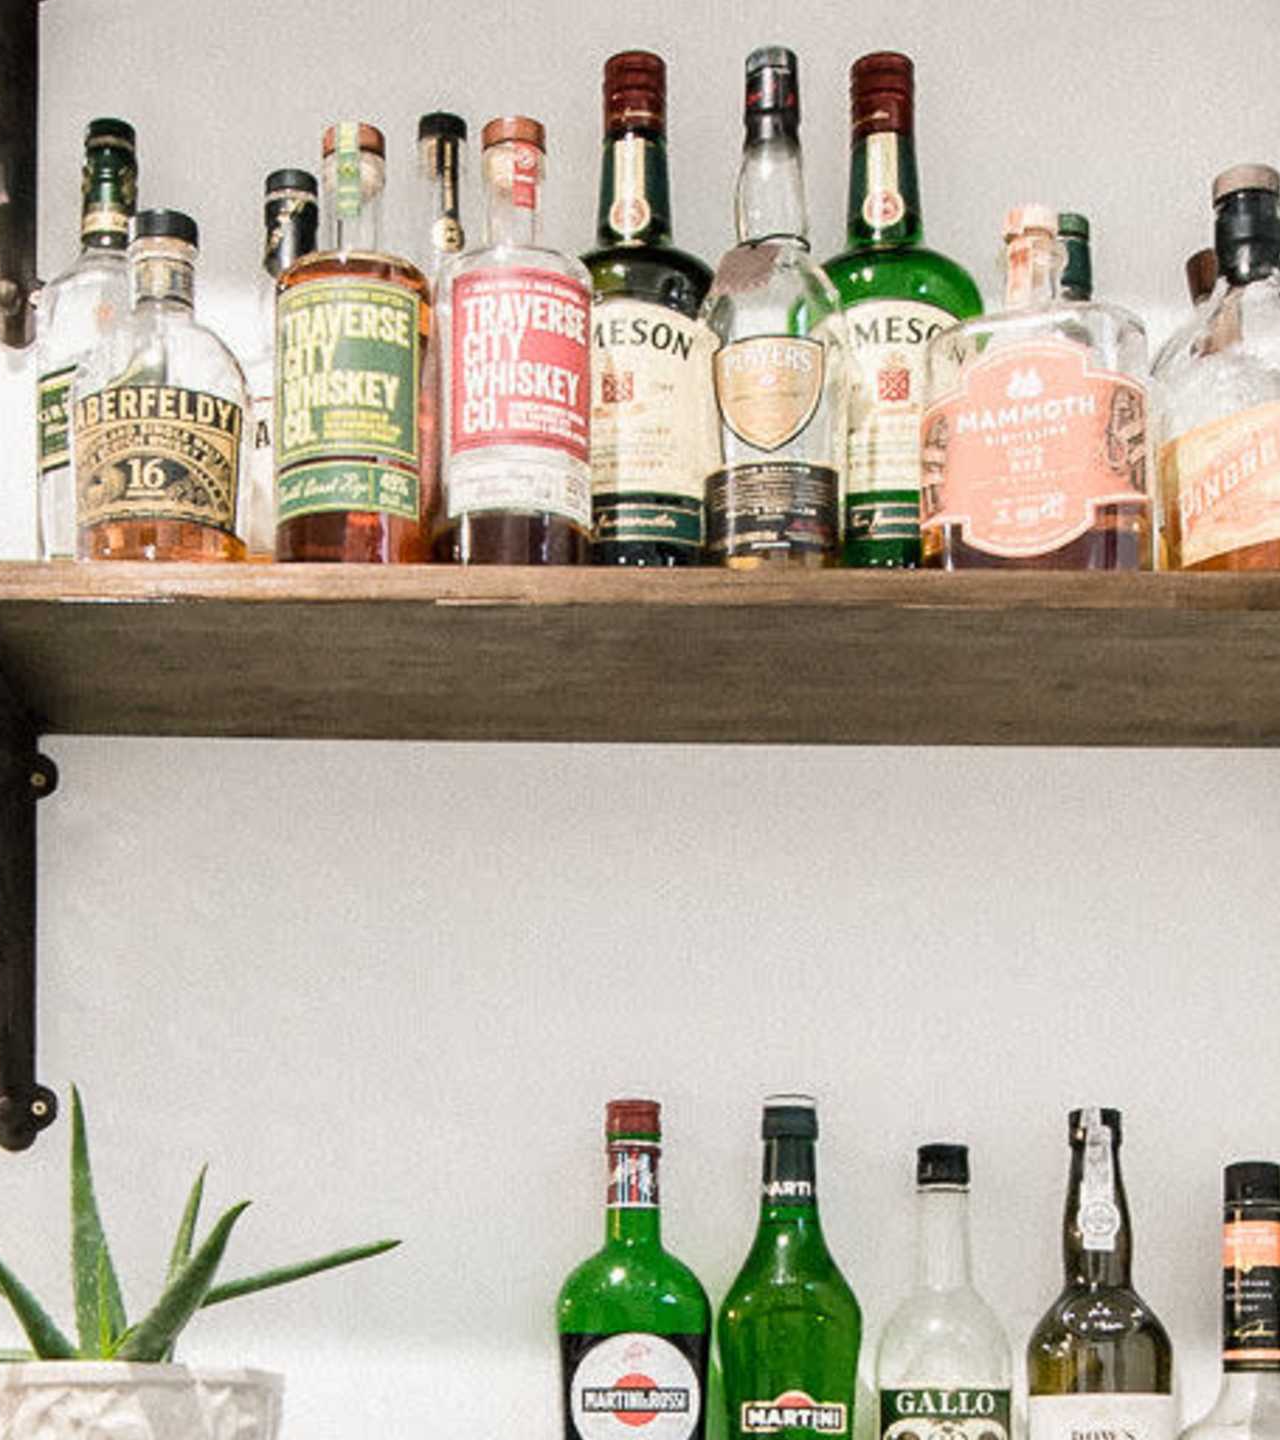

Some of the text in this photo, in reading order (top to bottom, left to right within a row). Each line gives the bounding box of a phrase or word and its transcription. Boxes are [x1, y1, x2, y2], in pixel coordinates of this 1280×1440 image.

[283, 303, 410, 349] TRAVERSE
[462, 292, 586, 345] TRAVERSE
[283, 338, 336, 382] CITY
[463, 326, 525, 361] CITY
[284, 369, 401, 421] WHISKEY
[464, 359, 580, 407] WHISKEY
[283, 408, 319, 448] CO.
[463, 399, 505, 434] CO.
[956, 395, 1096, 434] MAMMOTH
[126, 458, 167, 490] 16
[747, 1408, 841, 1429] MARTINI
[896, 1392, 995, 1414] GALLO
